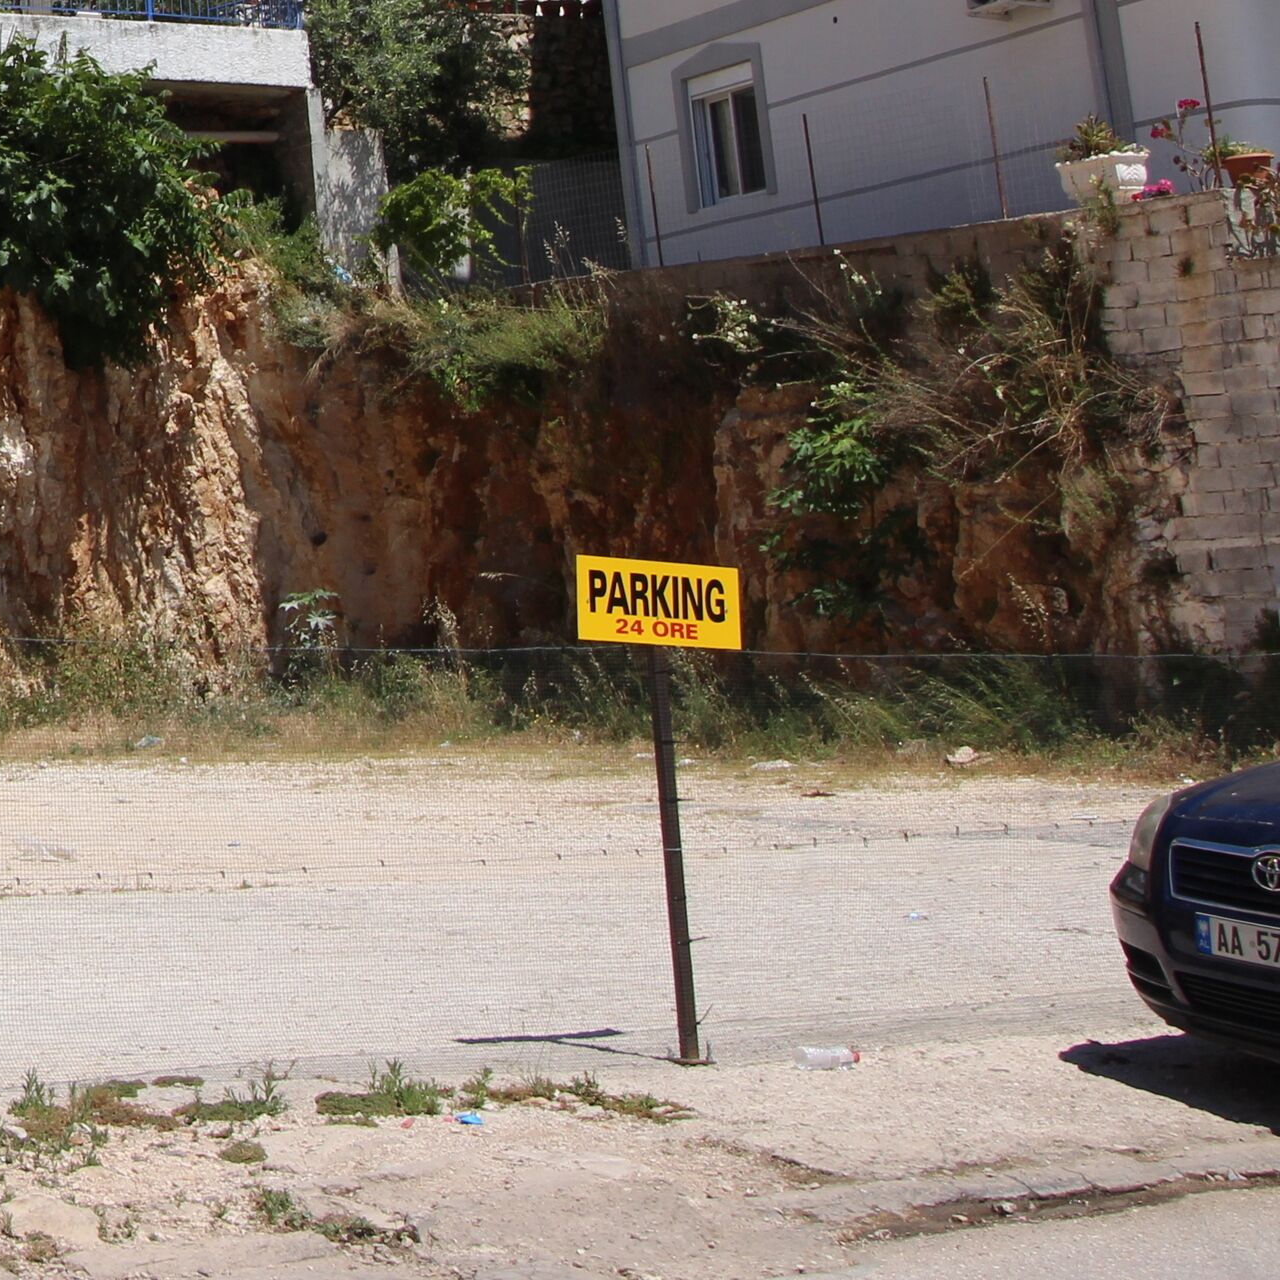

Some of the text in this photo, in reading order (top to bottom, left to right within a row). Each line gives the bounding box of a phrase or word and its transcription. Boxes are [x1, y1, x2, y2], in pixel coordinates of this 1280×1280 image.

[589, 569, 726, 623] PARKING
[616, 618, 698, 640] 24 ORE
[1217, 922, 1244, 957] AA
